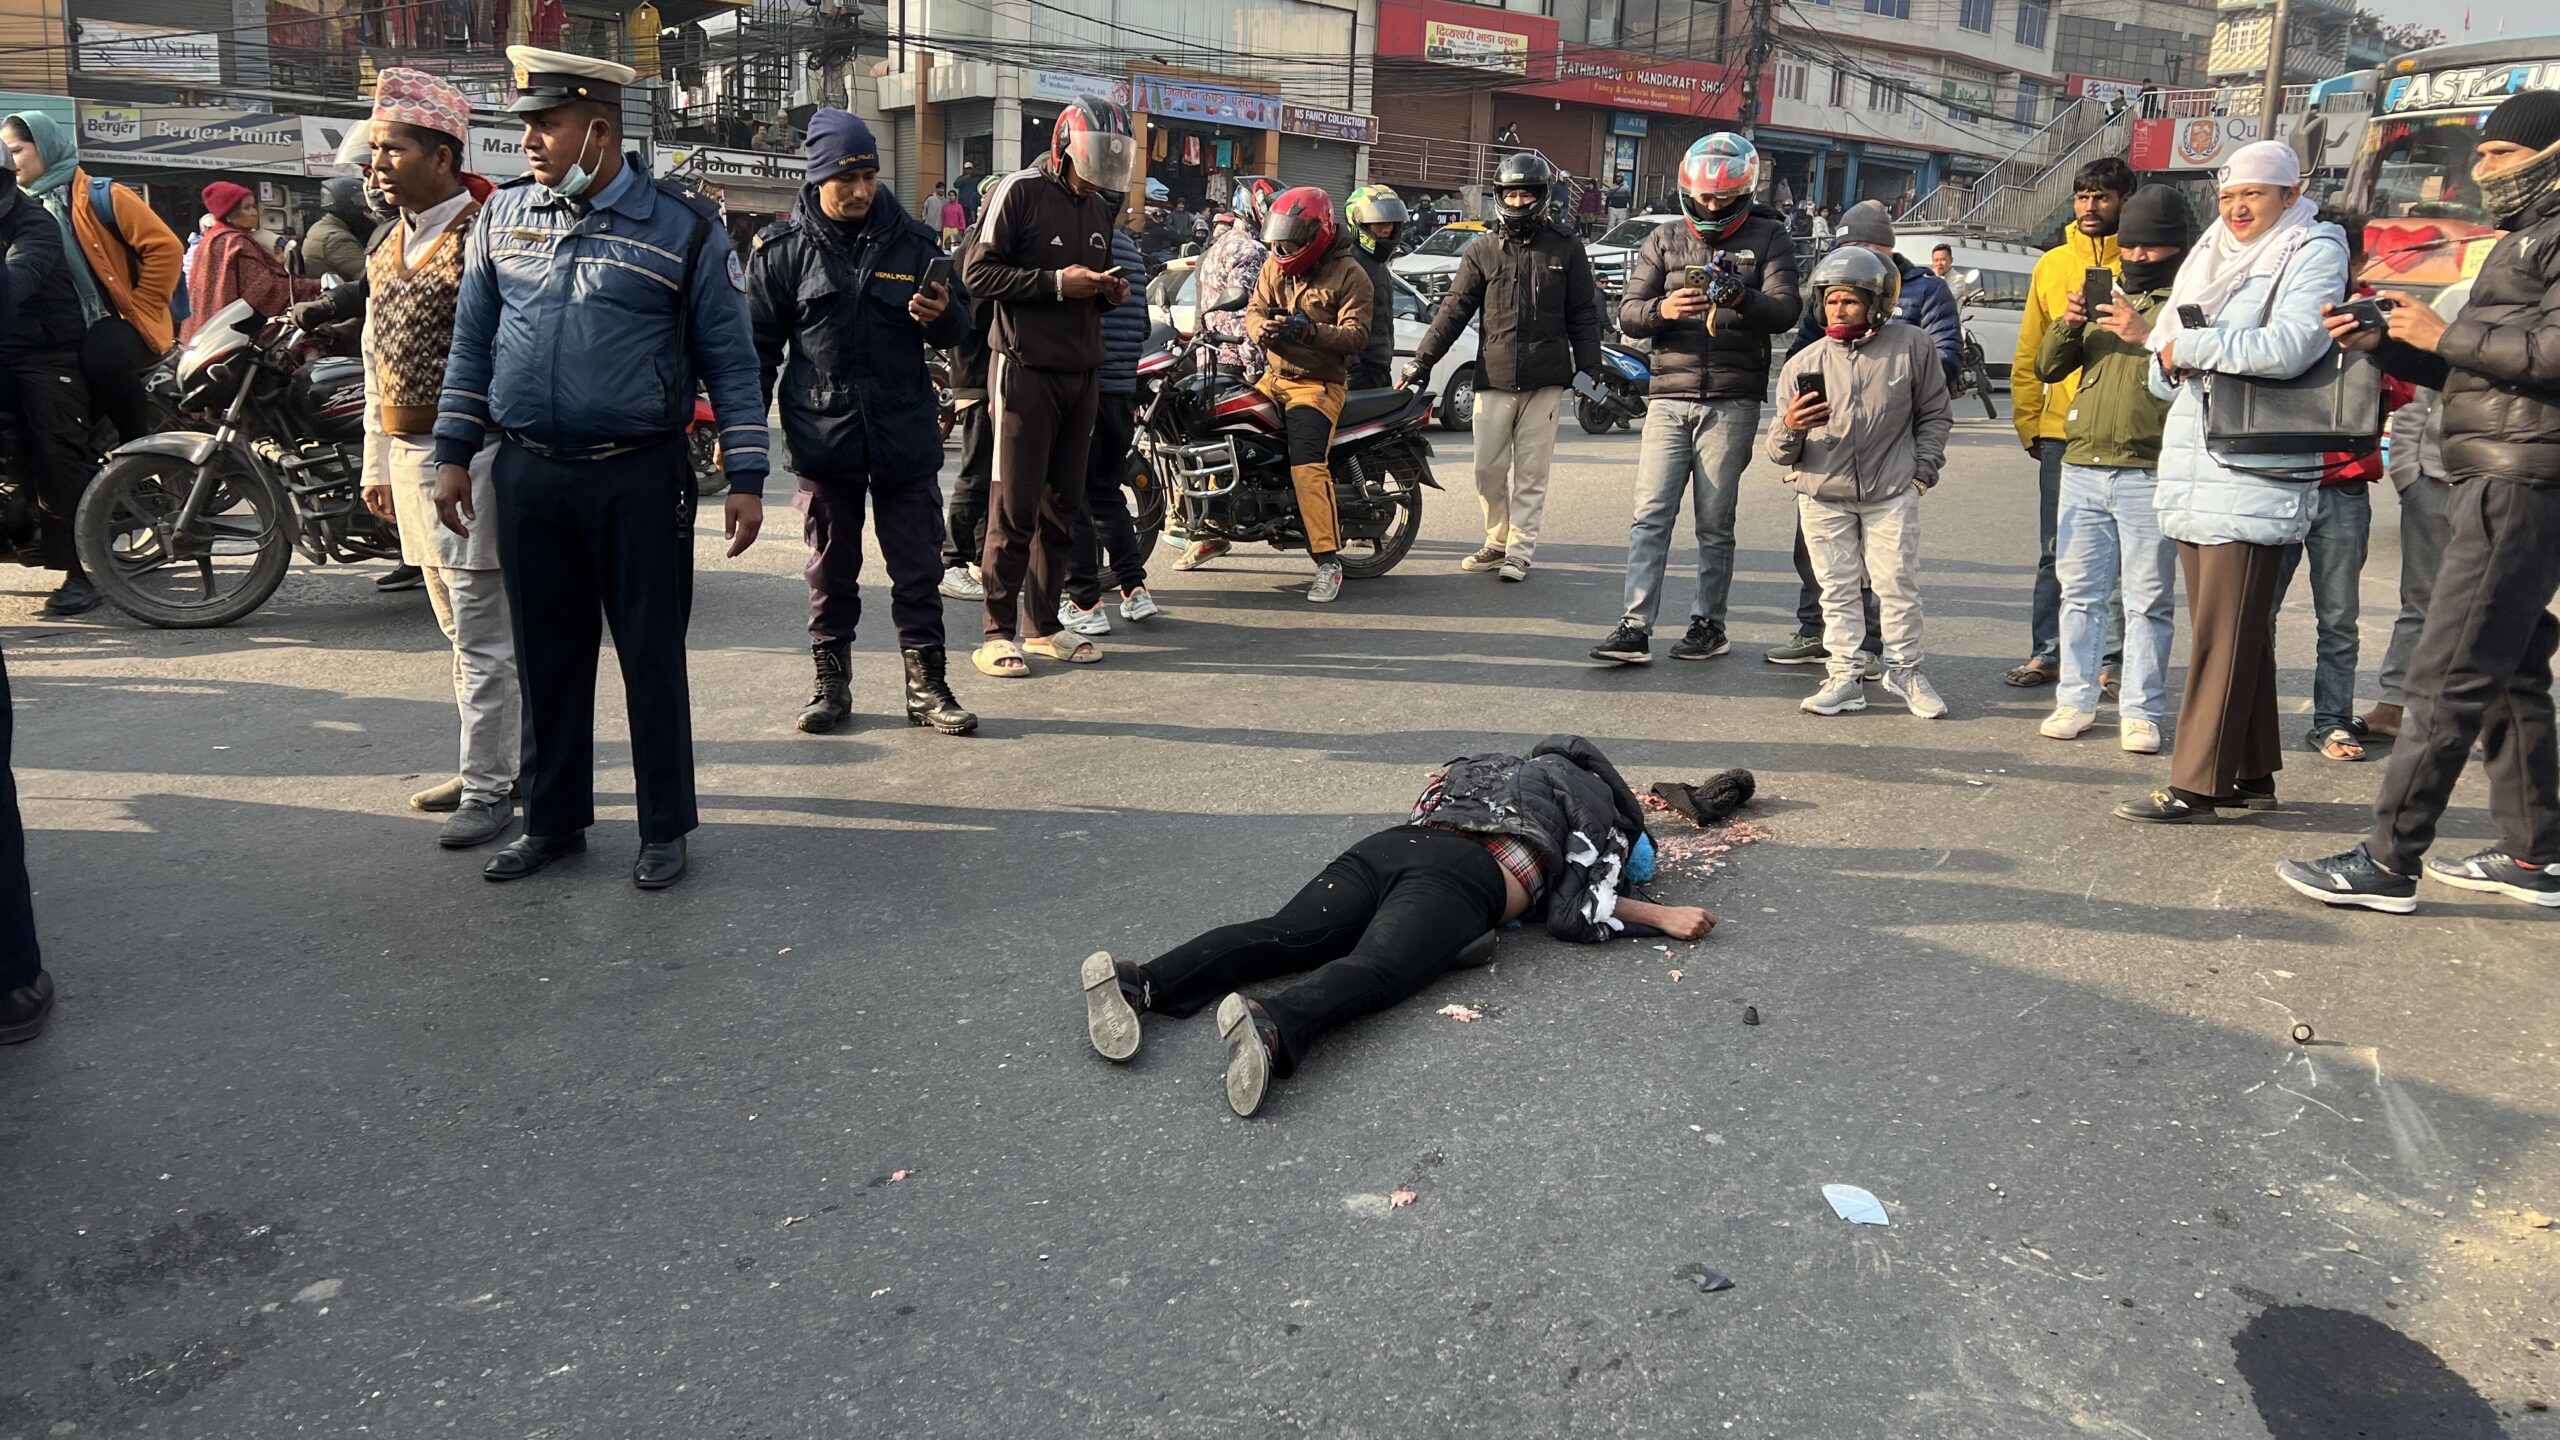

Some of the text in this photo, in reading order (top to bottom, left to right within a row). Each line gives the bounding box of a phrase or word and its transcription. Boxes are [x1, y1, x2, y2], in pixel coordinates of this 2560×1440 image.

[133, 38, 211, 60] MYSTIC
[1498, 36, 1519, 48] पसल
[1561, 61, 1622, 81] KATHMANDU
[1637, 71, 1698, 90] HANDICRAFT
[1594, 83, 1614, 94] Fancy
[1651, 90, 1691, 102] Supermarket
[2383, 63, 2560, 113] FAST AND FU
[88, 118, 136, 137] Berger
[1294, 108, 1367, 128] NS FANCY COLLECTION
[1628, 118, 1647, 128] ATM
[155, 120, 292, 147] Berger Paints
[2226, 118, 2289, 141] Qut
[482, 138, 527, 154] Mar
[874, 271, 895, 280] NEPAL
